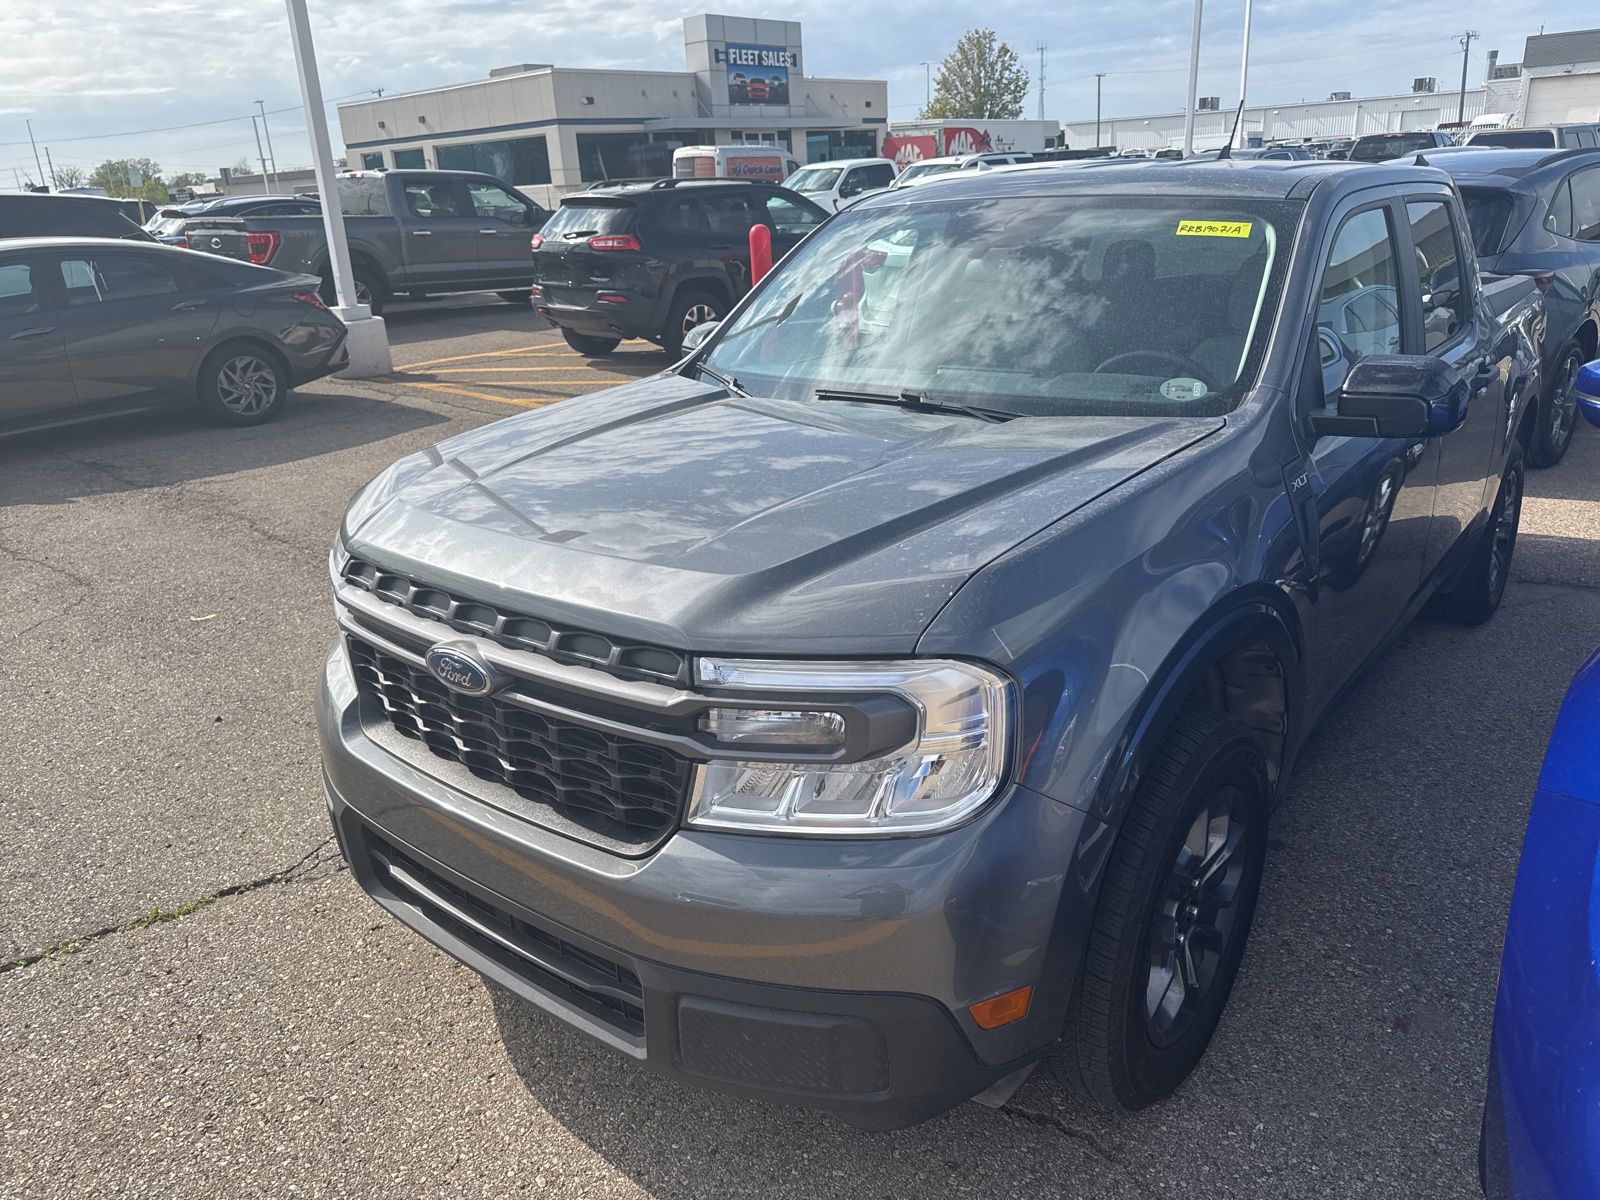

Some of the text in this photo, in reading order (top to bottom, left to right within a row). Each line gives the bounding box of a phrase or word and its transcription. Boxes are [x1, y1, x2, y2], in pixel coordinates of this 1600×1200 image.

[728, 48, 791, 67] FLEET SALES
[894, 143, 924, 164] MAC
[1290, 472, 1309, 493] XLT
[437, 657, 472, 687] Ford
